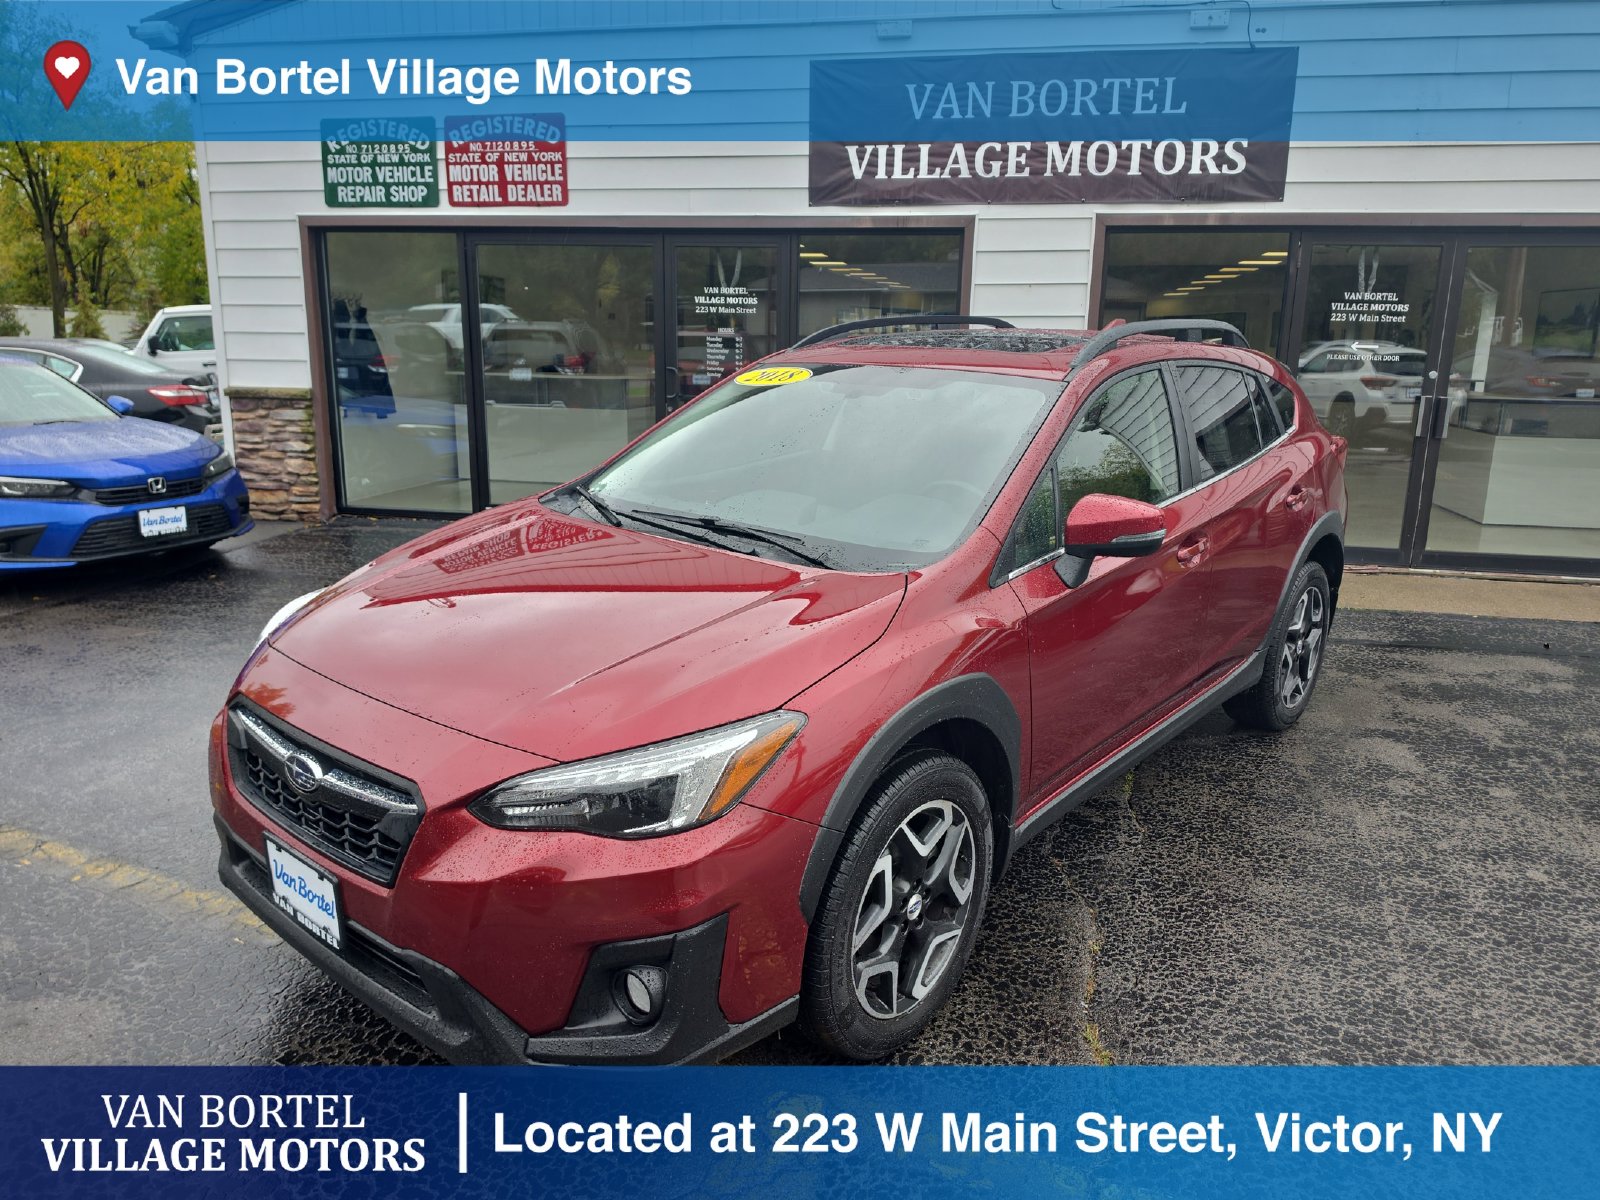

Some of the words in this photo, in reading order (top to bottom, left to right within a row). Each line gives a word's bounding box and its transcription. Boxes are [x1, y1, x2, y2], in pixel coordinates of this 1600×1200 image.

[906, 81, 996, 120] VAN
[1009, 77, 1188, 117] BORTEL
[326, 119, 430, 153] REGISTERED
[448, 116, 560, 148] REGISTERED
[360, 144, 411, 154] 7120895
[485, 141, 536, 151] 7120895
[327, 154, 358, 164] STATE
[360, 154, 374, 163] OF
[376, 153, 400, 163] NEW
[402, 153, 431, 163] YORK
[448, 153, 481, 162] STATE
[485, 153, 500, 162] OF
[504, 152, 528, 162] NEW
[532, 152, 562, 161] YORK
[845, 141, 1031, 180] VILLAGE
[1043, 138, 1249, 178] MOTORS
[327, 167, 373, 183] MOTOR
[375, 166, 434, 183] VEHICLE
[449, 165, 499, 182] MOTOR
[504, 164, 563, 181] VEHICLE
[337, 186, 386, 202] REPAIR
[389, 185, 428, 202] SHOP
[452, 185, 502, 202] RETAIL
[507, 184, 562, 201] DEALER
[694, 296, 725, 304] VILLAGE
[1344, 292, 1362, 300] VAN
[1364, 293, 1398, 301] BORTEL
[1331, 302, 1369, 311] VILLAGE
[1370, 304, 1409, 312] MOTORS
[1330, 313, 1347, 321] 223
[1358, 314, 1379, 322] Main
[1381, 314, 1406, 322] Street
